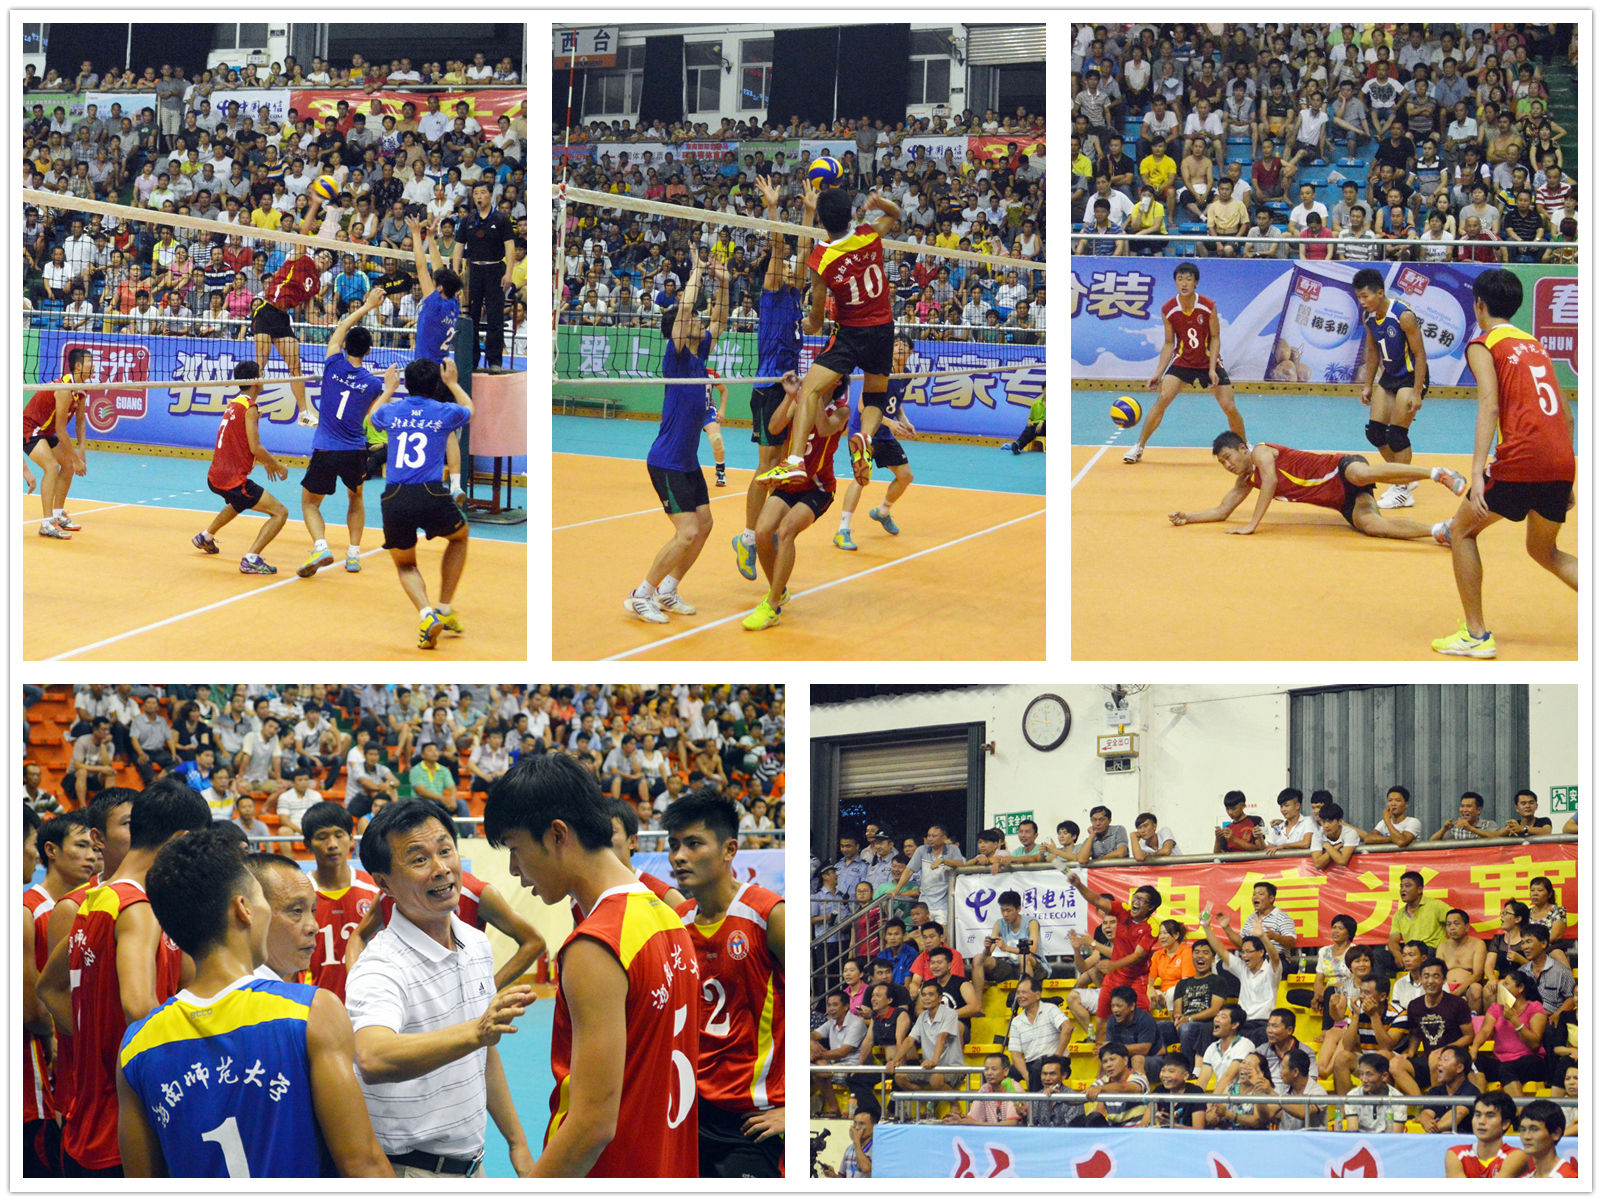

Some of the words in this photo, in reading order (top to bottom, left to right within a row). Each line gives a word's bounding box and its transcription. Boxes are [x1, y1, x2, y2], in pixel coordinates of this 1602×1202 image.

[560, 28, 611, 54] 西台
[844, 263, 883, 305] 10
[440, 326, 455, 351] 2
[1187, 327, 1199, 349] 8
[1378, 338, 1392, 362] 1
[1540, 336, 1573, 351] CHUN
[115, 396, 143, 411] GUANG
[1529, 365, 1558, 416] 5
[335, 389, 351, 420] 1
[885, 396, 897, 415] 8
[218, 418, 229, 449] 7
[395, 431, 428, 469] 13
[1034, 911, 1077, 920] TELECOM
[1003, 981, 1012, 989] 21
[703, 978, 730, 1036] 2
[667, 1004, 697, 1130] 5
[152, 1056, 291, 1128] 海南师范大学
[1078, 1082, 1087, 1090] 21
[201, 1116, 250, 1178] 1
